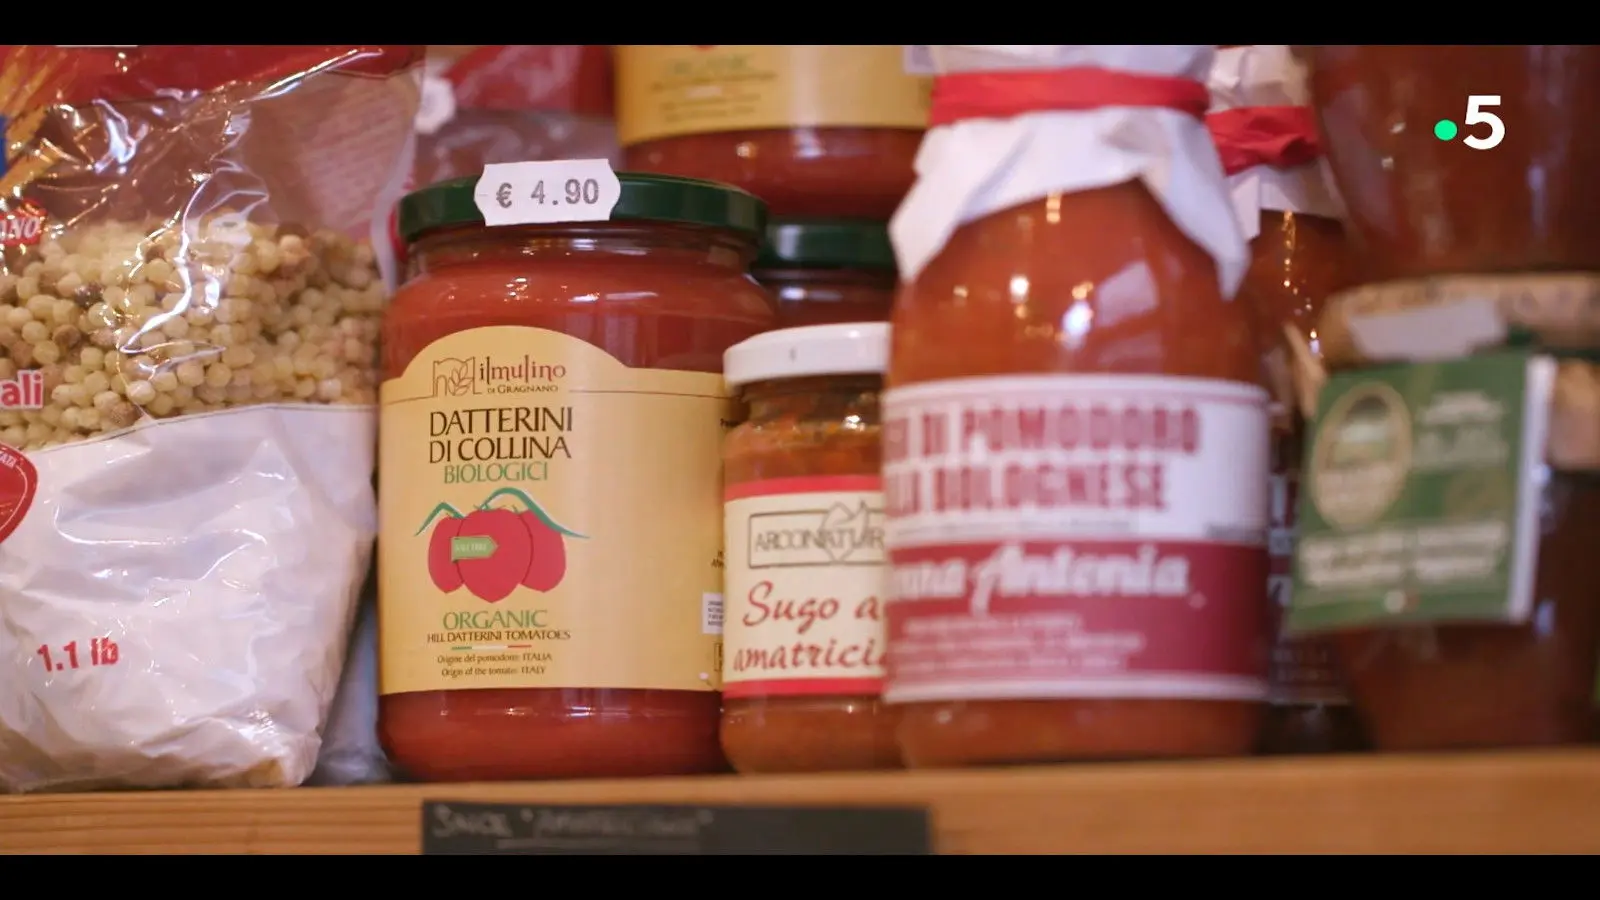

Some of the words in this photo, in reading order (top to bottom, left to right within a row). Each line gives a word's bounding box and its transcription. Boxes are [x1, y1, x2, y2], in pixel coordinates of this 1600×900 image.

[496, 183, 512, 208] €
[530, 178, 599, 206] 4.90
[497, 384, 558, 394] GRAGNANO
[430, 407, 573, 437] DATTERINI
[429, 440, 451, 464] DI
[457, 436, 572, 461] COLLINA
[444, 461, 548, 484] BIOLOGICI
[935, 463, 1166, 512] BOLOGNESE
[743, 580, 839, 634] Sugo
[442, 609, 549, 631] ORGANIC
[427, 632, 446, 643] HILL
[447, 630, 502, 642] DATTERINI
[505, 629, 571, 641] TOMATOES
[37, 640, 80, 672] 1.1
[522, 652, 552, 661] ITALIA
[521, 665, 546, 674] ITALY
